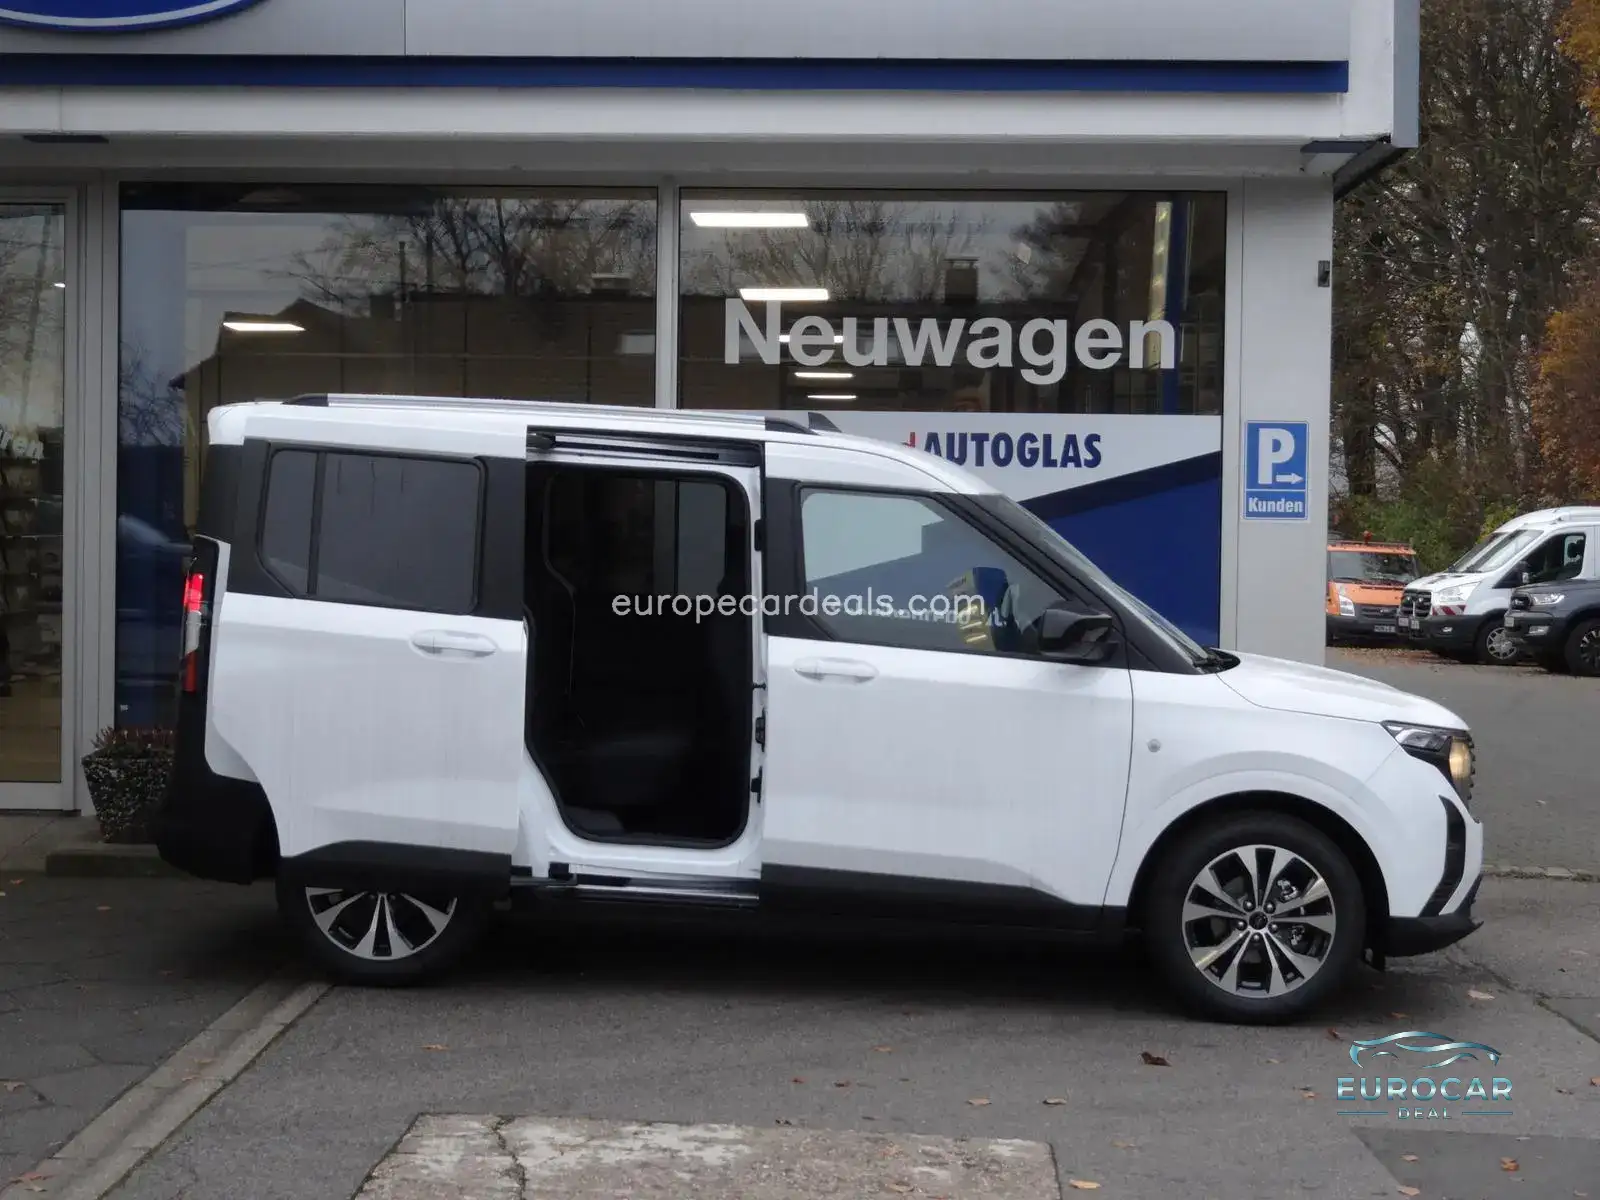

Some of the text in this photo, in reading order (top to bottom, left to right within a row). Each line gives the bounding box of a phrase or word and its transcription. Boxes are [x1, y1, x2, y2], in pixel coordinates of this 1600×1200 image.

[725, 298, 1175, 385] Neuwagen
[924, 431, 1102, 468] AUTOGLAS
[1258, 427, 1295, 484] P
[1248, 497, 1304, 513] Kunden
